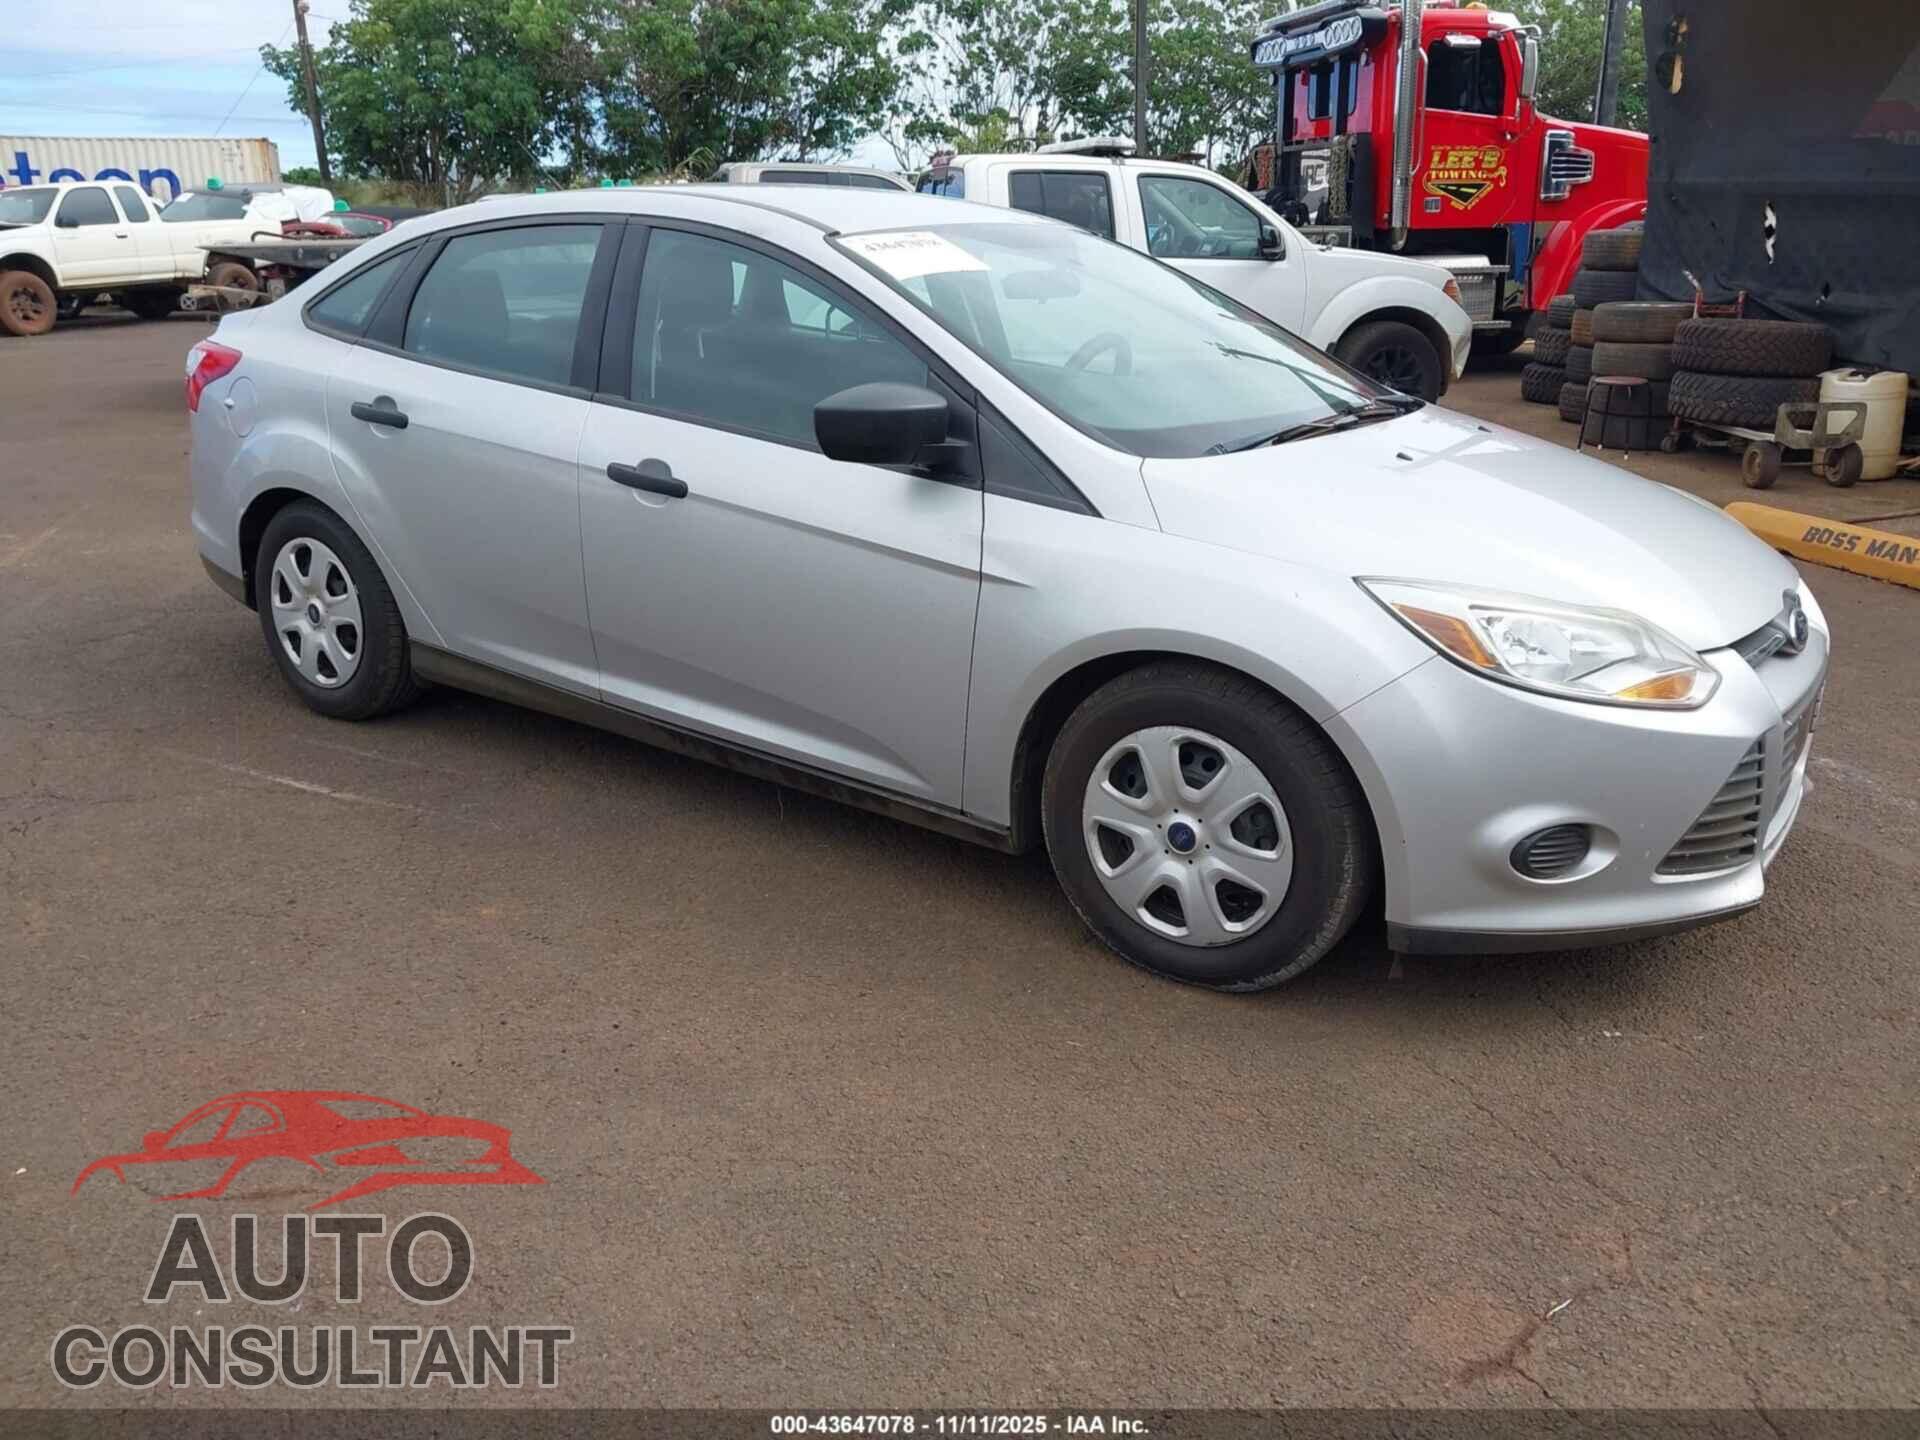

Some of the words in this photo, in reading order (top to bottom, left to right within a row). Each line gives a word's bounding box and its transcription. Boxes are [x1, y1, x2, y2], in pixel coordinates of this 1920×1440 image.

[1430, 150, 1501, 169] LEE'S
[1430, 170, 1487, 179] TOWING
[1801, 526, 1862, 552] BOSS
[1865, 538, 1919, 564] MAN
